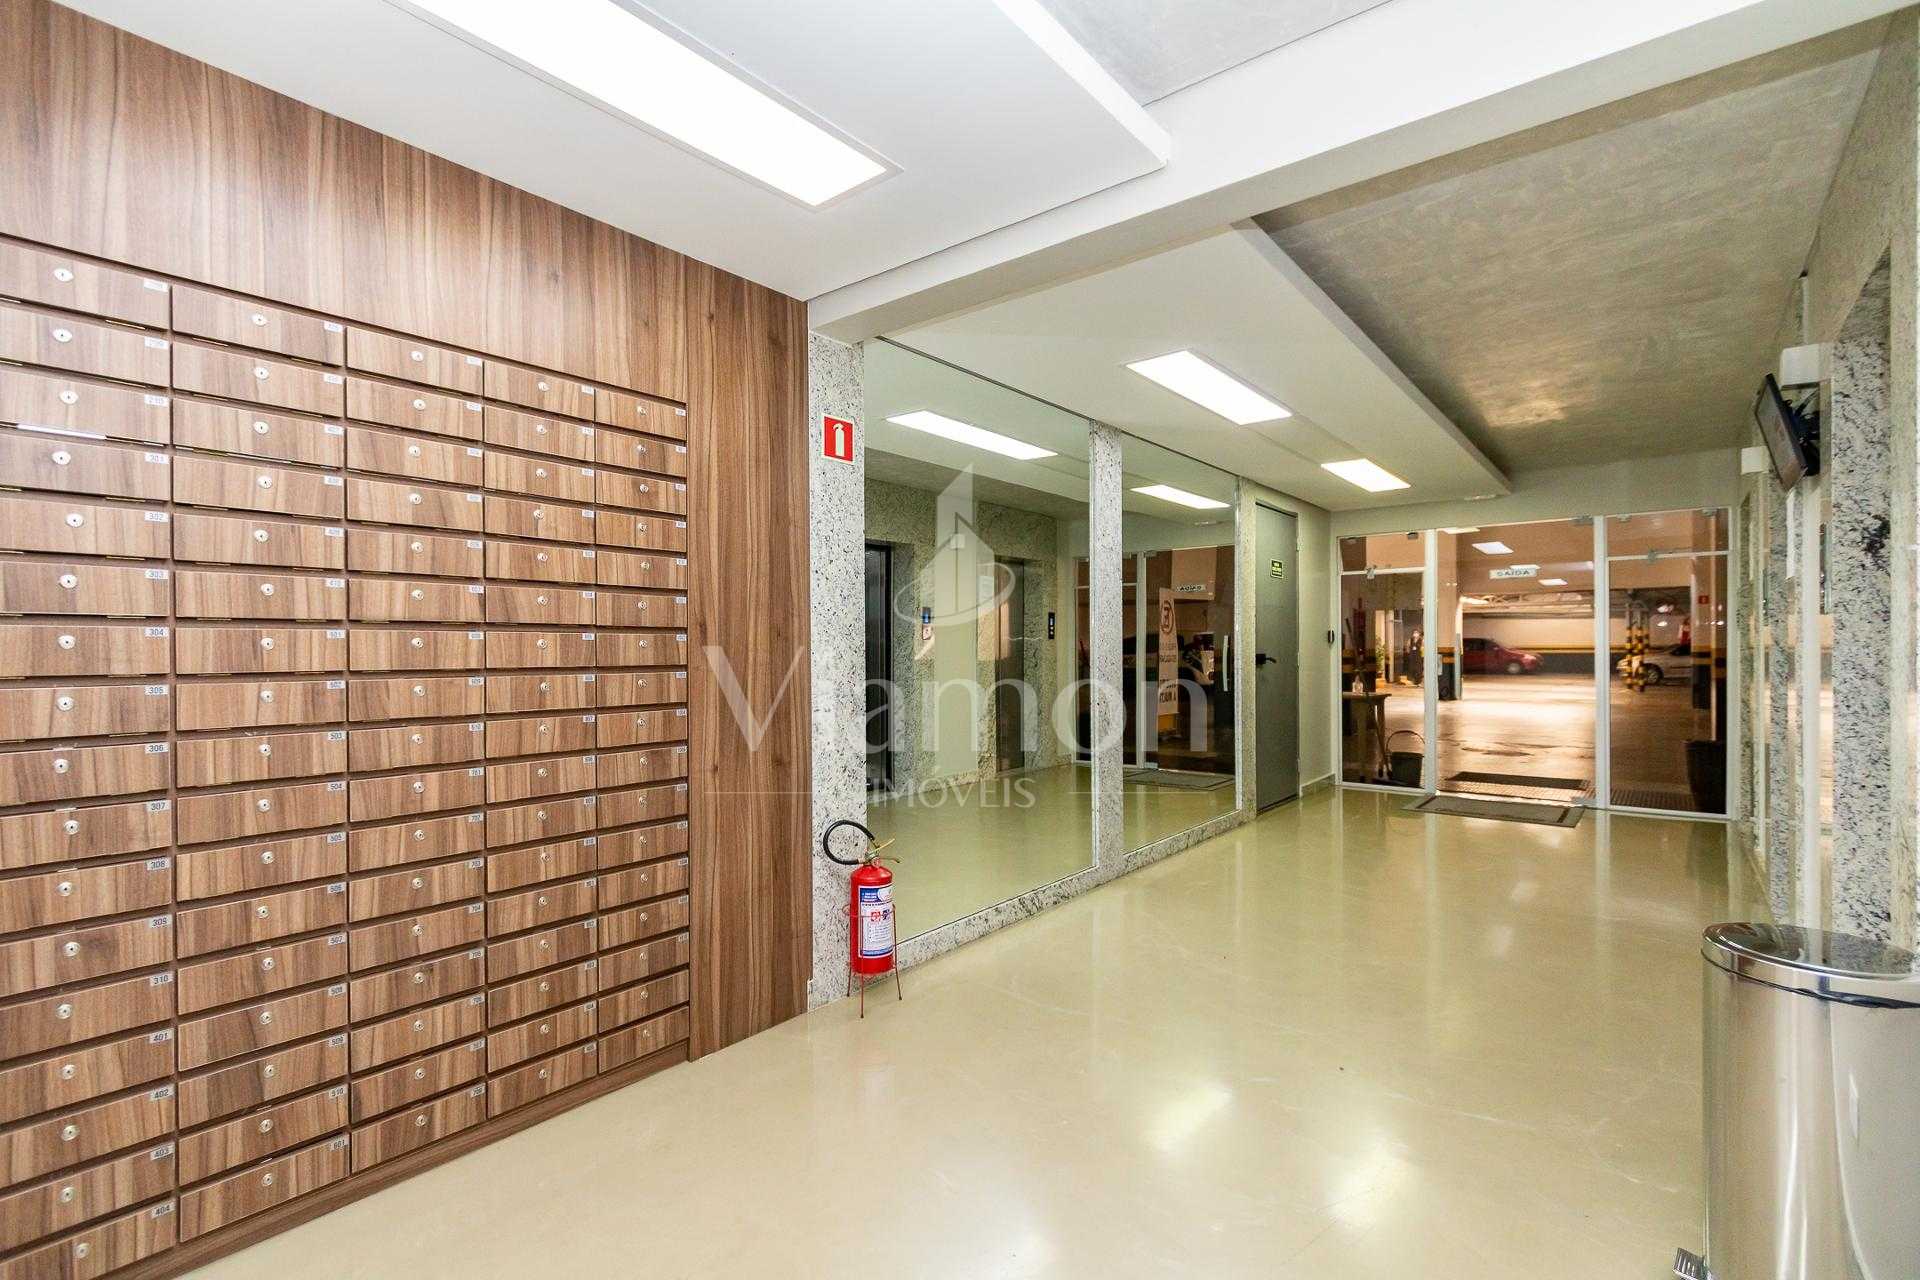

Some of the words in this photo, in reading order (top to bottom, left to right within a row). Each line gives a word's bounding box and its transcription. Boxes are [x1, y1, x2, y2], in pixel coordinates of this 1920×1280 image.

[149, 512, 165, 521] 302
[150, 626, 164, 636] 304
[150, 685, 165, 695] 305
[149, 743, 165, 753] 306
[150, 801, 166, 811] 307
[150, 859, 167, 869] 308
[153, 974, 169, 985] 310
[153, 1031, 168, 1042] 401
[154, 1088, 169, 1099] 402
[155, 1204, 170, 1216] 404
